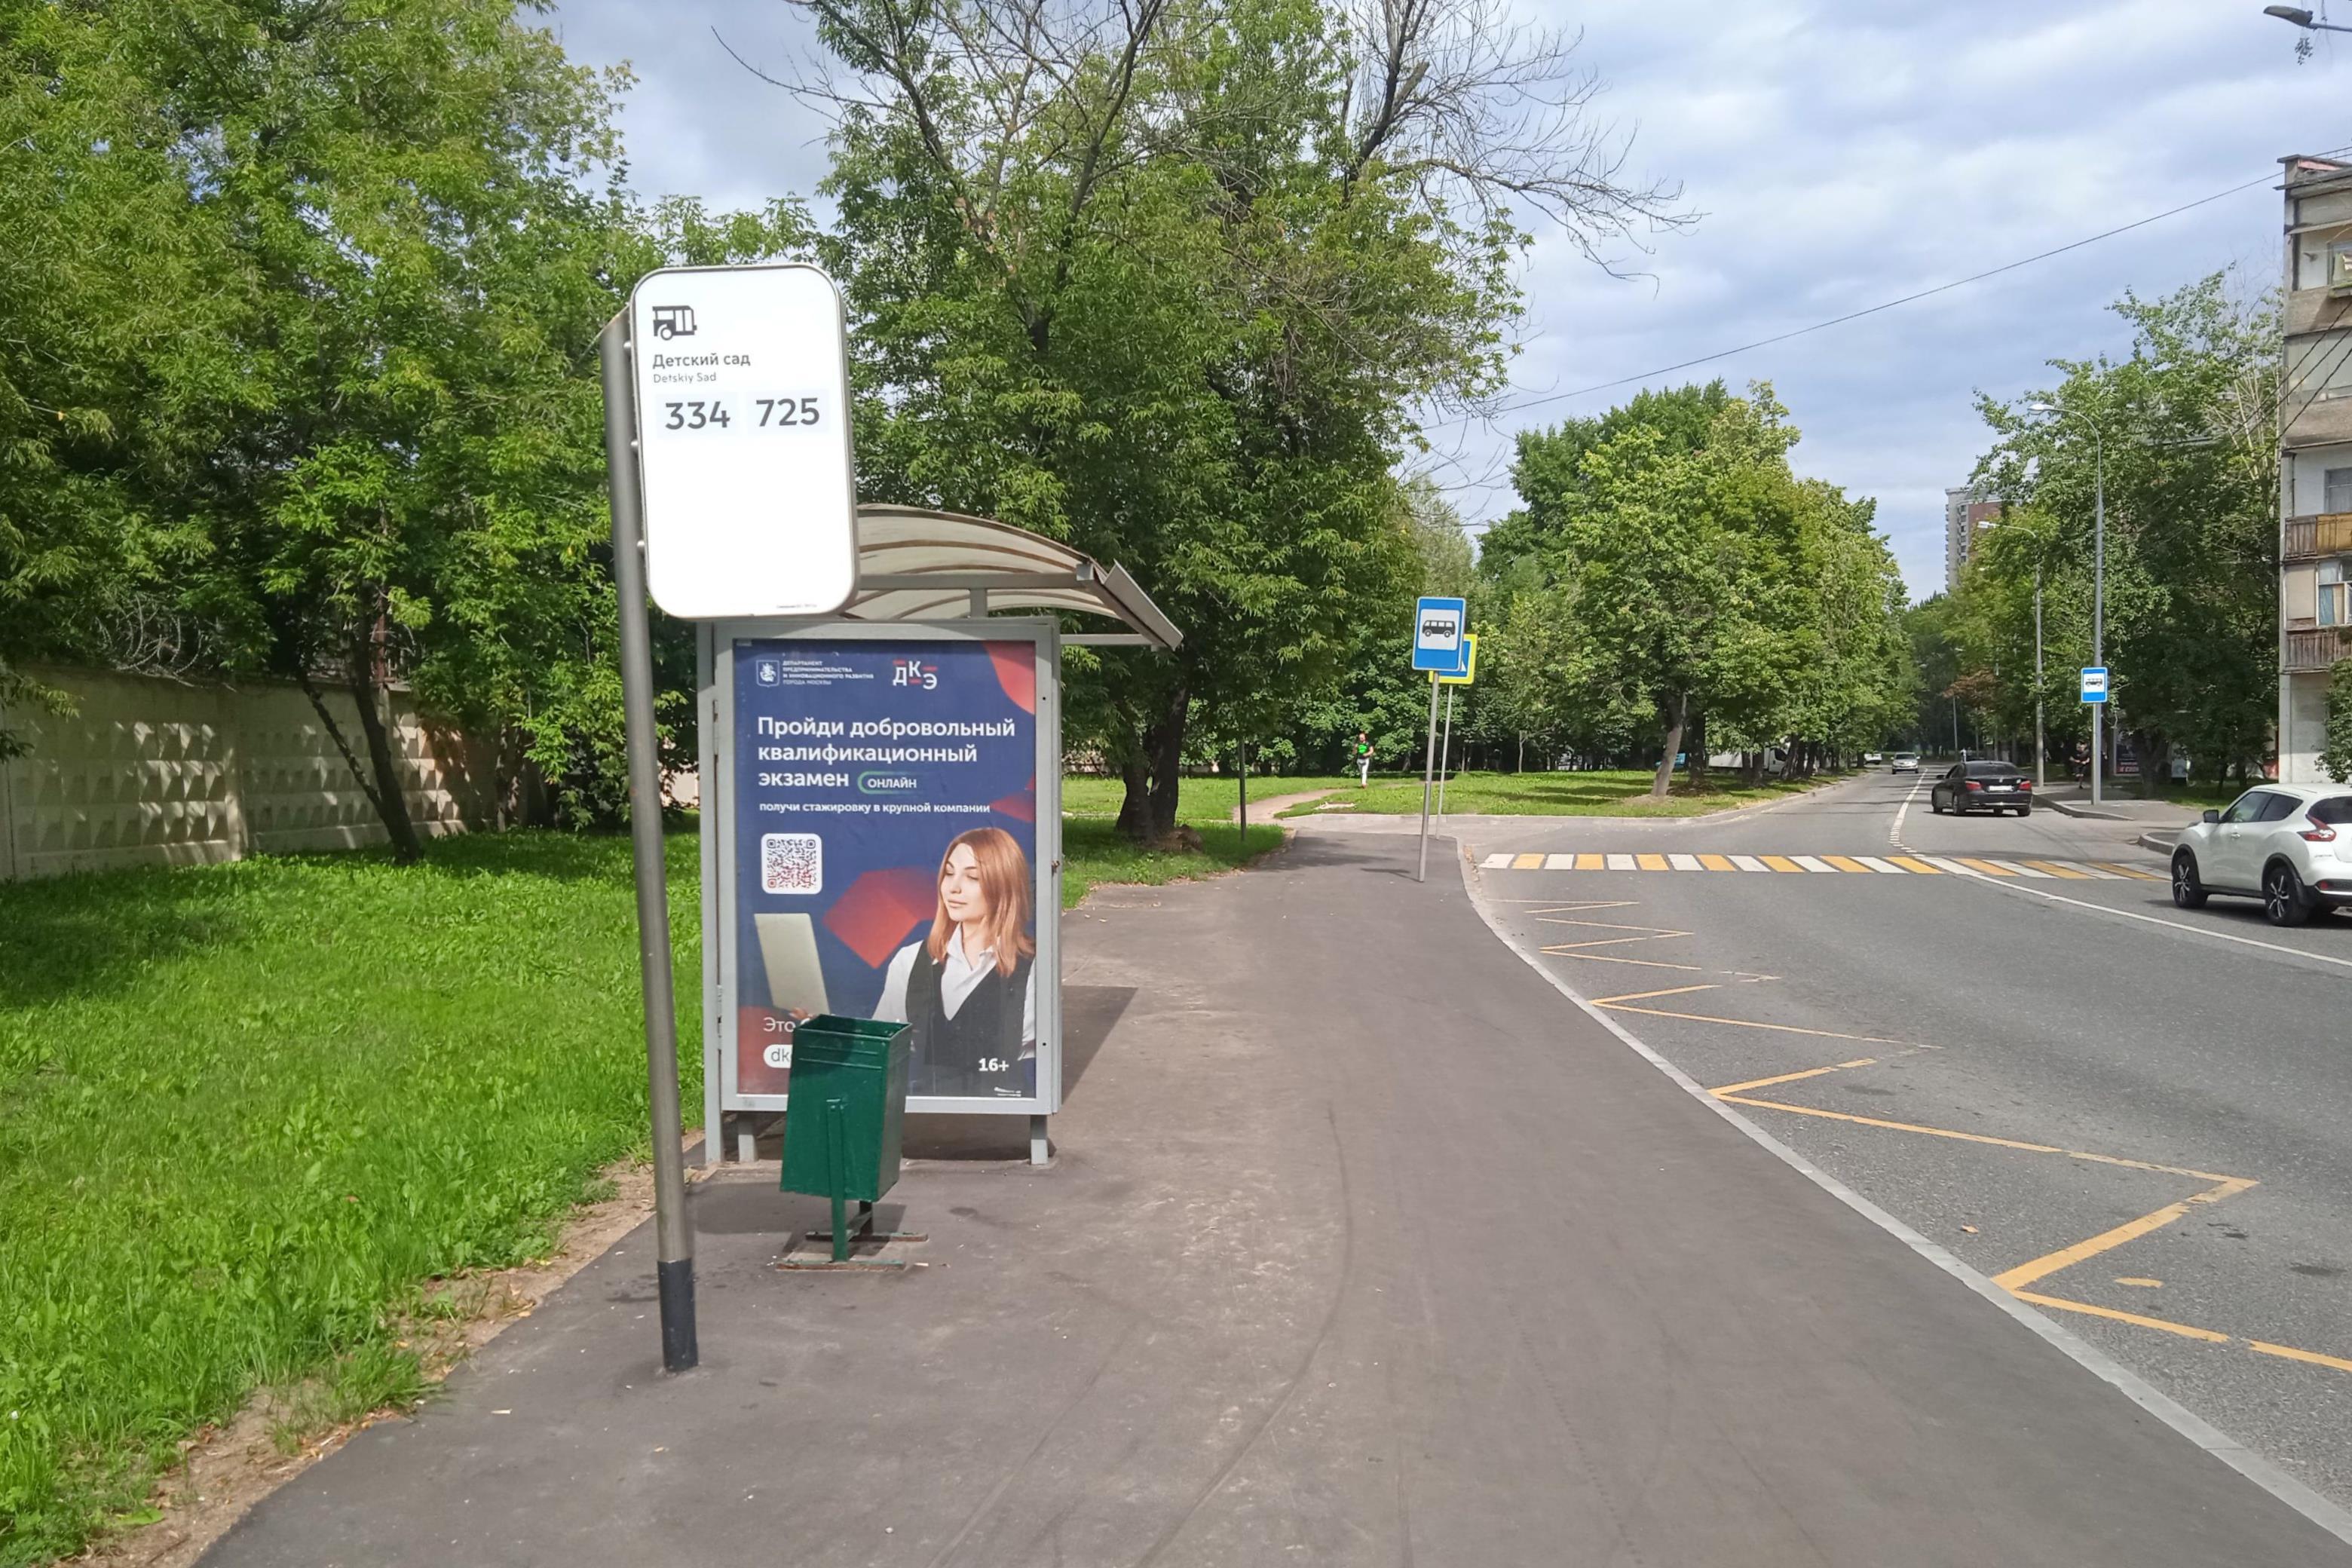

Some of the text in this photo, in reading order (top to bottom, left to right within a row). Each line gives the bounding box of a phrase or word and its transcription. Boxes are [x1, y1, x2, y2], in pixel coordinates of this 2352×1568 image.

[652, 352, 751, 369] Детский сад
[653, 372, 716, 384] Detskiy Sad
[665, 397, 820, 430] 334 725
[893, 660, 938, 690] ДКЭ
[758, 716, 1015, 740] Пройди добровольный
[758, 743, 978, 765] квалификационный
[758, 772, 917, 789] экзамен ОНЛАЙН
[759, 803, 800, 813] получи
[802, 804, 871, 813] стажировку
[883, 803, 932, 814] крупной
[933, 804, 991, 813] компании
[763, 1017, 796, 1032] Это
[770, 1048, 792, 1062] dk
[978, 1058, 1009, 1071] 16+
